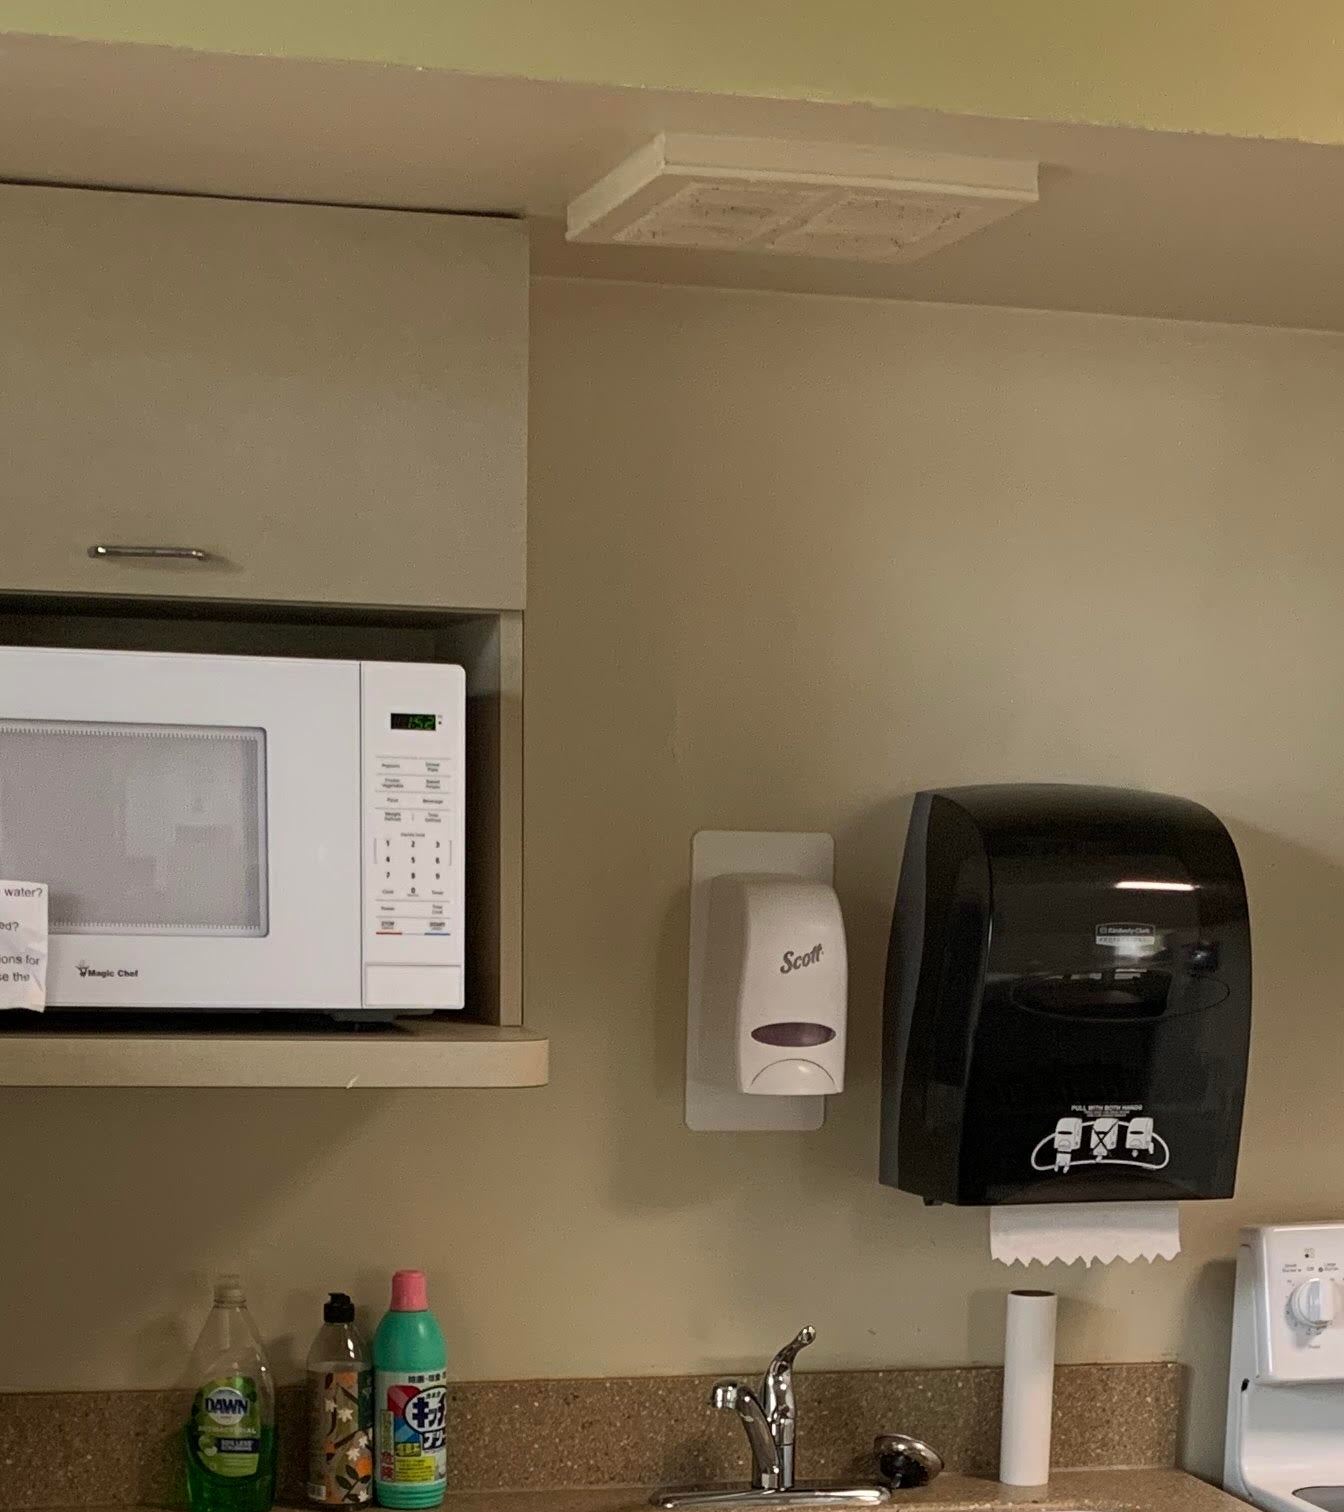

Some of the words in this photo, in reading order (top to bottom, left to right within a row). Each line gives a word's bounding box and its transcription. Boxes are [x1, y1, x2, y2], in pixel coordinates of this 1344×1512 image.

[4, 887, 43, 898] water?
[25, 954, 40, 966] for
[780, 943, 823, 974] Scott
[12, 971, 30, 982] the
[88, 969, 115, 979] Magic
[117, 969, 138, 978] Chef
[204, 1398, 248, 1414] DAWN
